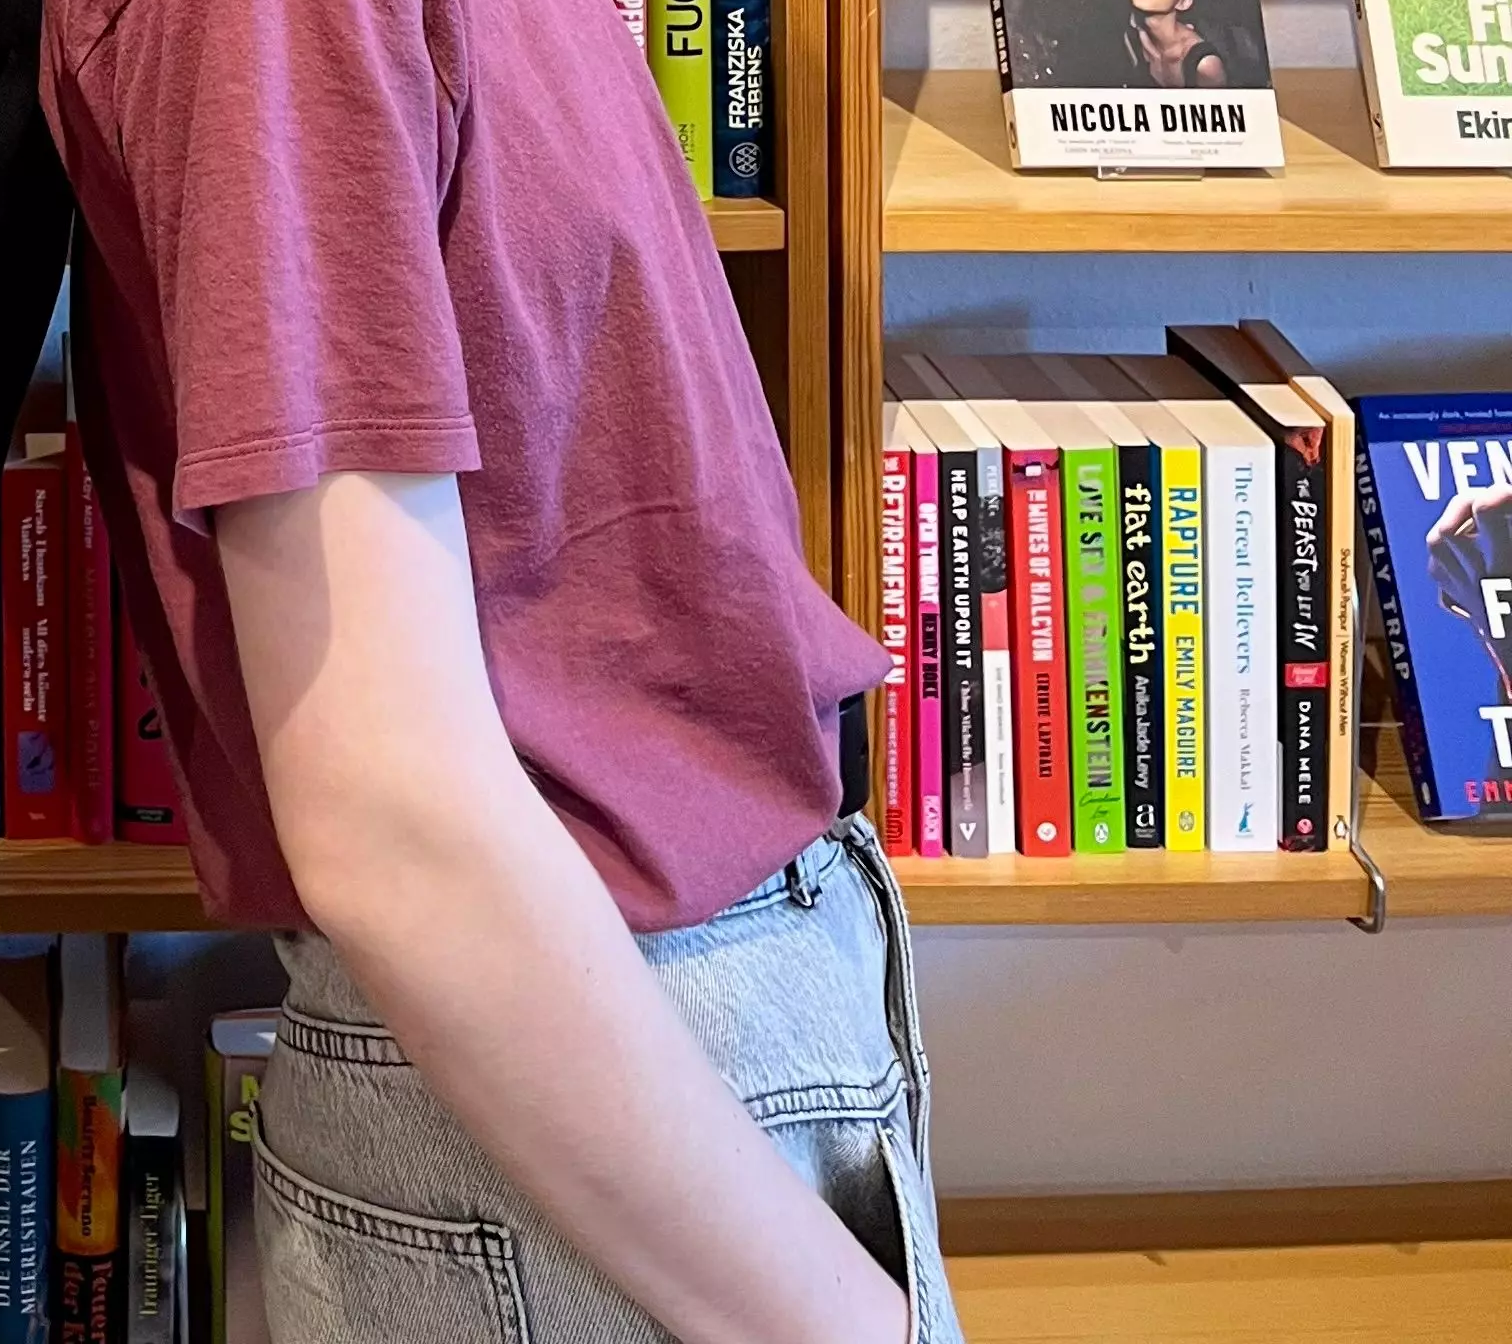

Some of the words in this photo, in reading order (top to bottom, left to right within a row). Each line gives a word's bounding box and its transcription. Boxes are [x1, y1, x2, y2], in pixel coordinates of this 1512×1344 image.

[728, 7, 746, 129] FRANZISKA
[746, 45, 765, 129] JEBENS
[1051, 103, 1152, 133] NICOLA
[1162, 103, 1247, 134] DINAN
[950, 469, 968, 522] HEAP
[1123, 483, 1151, 551] flat
[951, 525, 970, 589] EARTH
[1167, 487, 1199, 615] RAPTURE
[1291, 500, 1318, 568] BEAST
[953, 593, 971, 646] UPON
[1126, 560, 1152, 665] earth
[954, 650, 972, 670] IT
[1175, 635, 1195, 693] EMILY
[1175, 698, 1196, 778] MAGUIRE
[1298, 700, 1311, 751] DANA
[1298, 757, 1312, 805] MELE
[21, 1140, 37, 1314] MEERESFRAUEN
